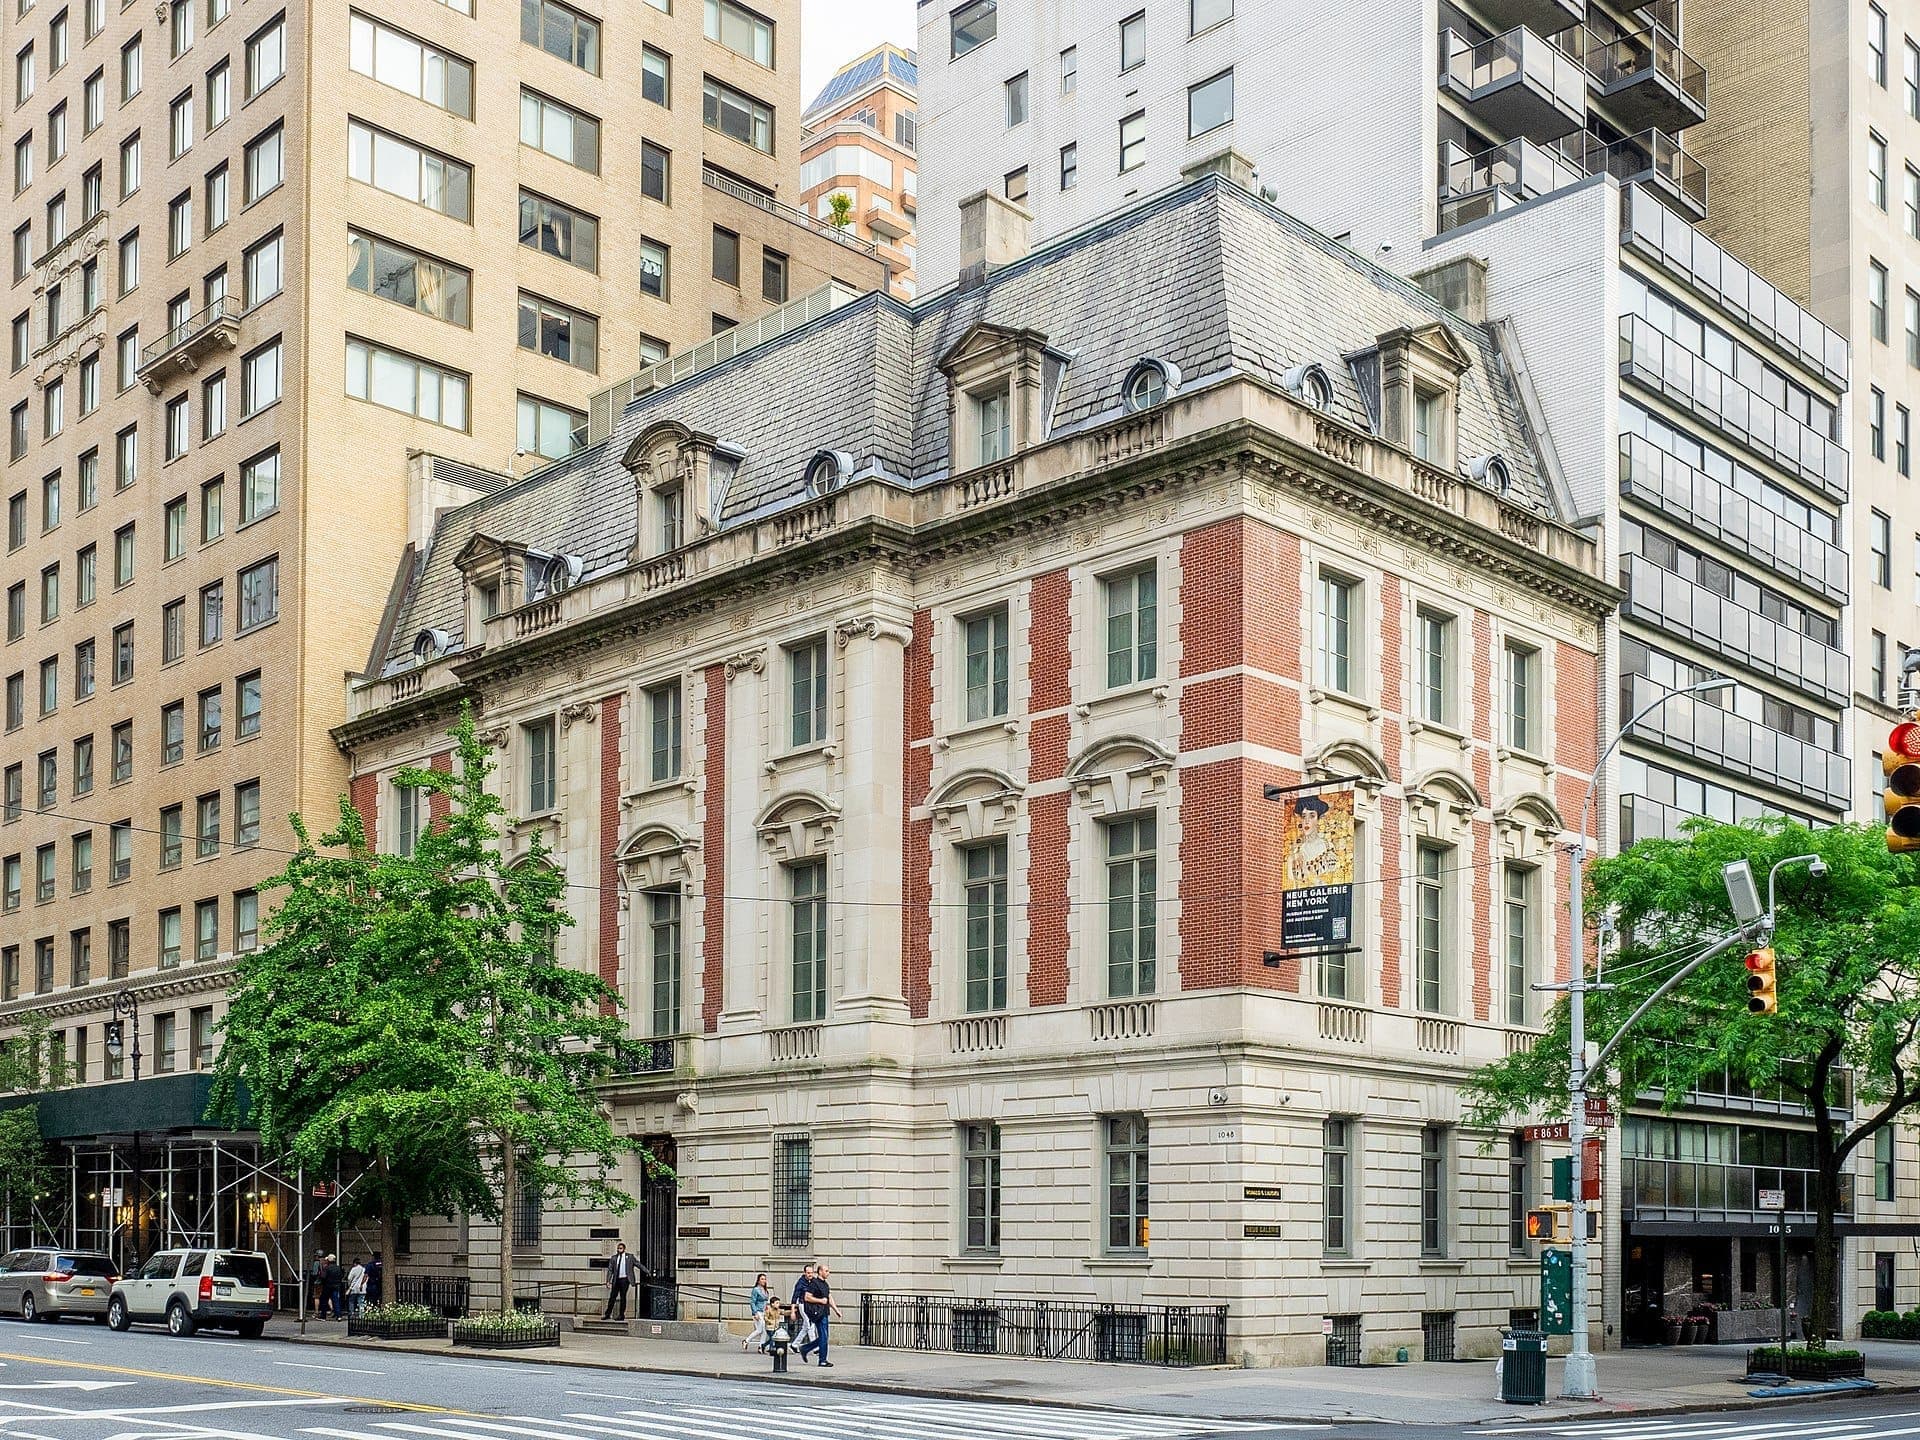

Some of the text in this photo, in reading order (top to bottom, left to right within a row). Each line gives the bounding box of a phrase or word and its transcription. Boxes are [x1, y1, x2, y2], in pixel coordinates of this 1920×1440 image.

[1286, 886, 1348, 900] NEUE GALERIE
[1286, 896, 1329, 908] NEW YORK
[1585, 1115, 1603, 1126] useum
[1218, 1131, 1235, 1139] 1048
[1533, 1127, 1562, 1139] E 86 St
[1769, 1225, 1792, 1234] 105
